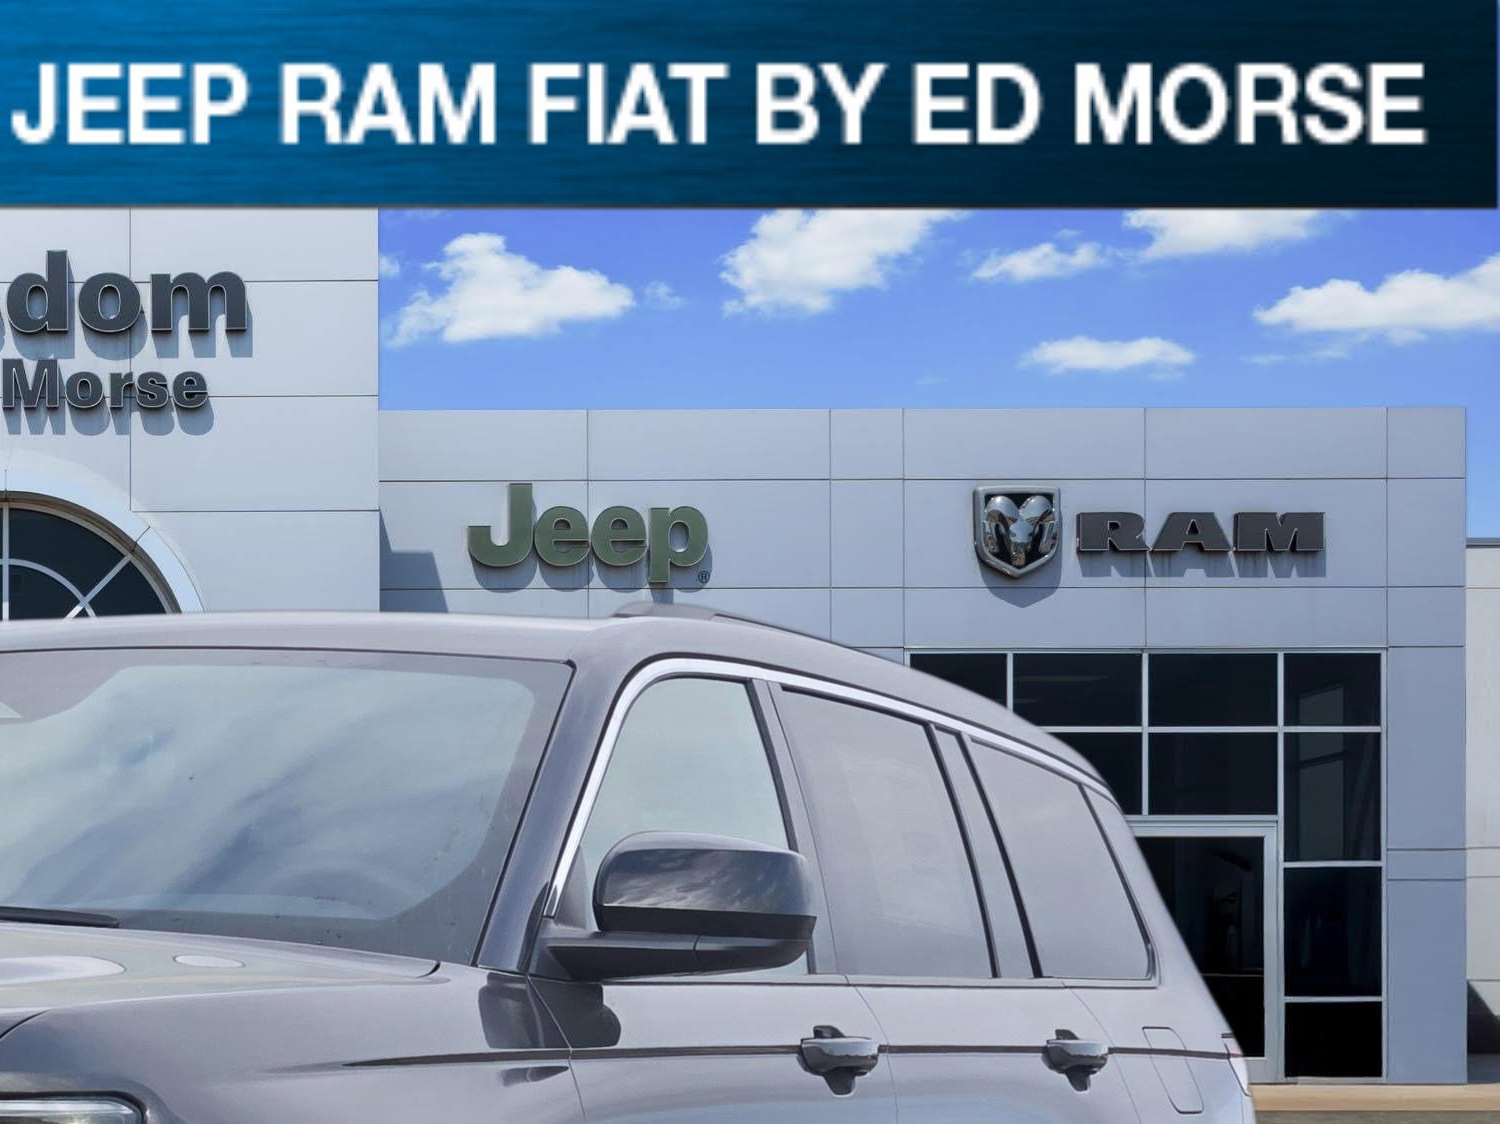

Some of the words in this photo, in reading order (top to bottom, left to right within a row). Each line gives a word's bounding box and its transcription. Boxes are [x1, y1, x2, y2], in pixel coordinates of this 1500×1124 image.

[2, 358, 210, 410] Morse
[467, 482, 709, 583] Jeep
[1076, 511, 1325, 551] RAM
